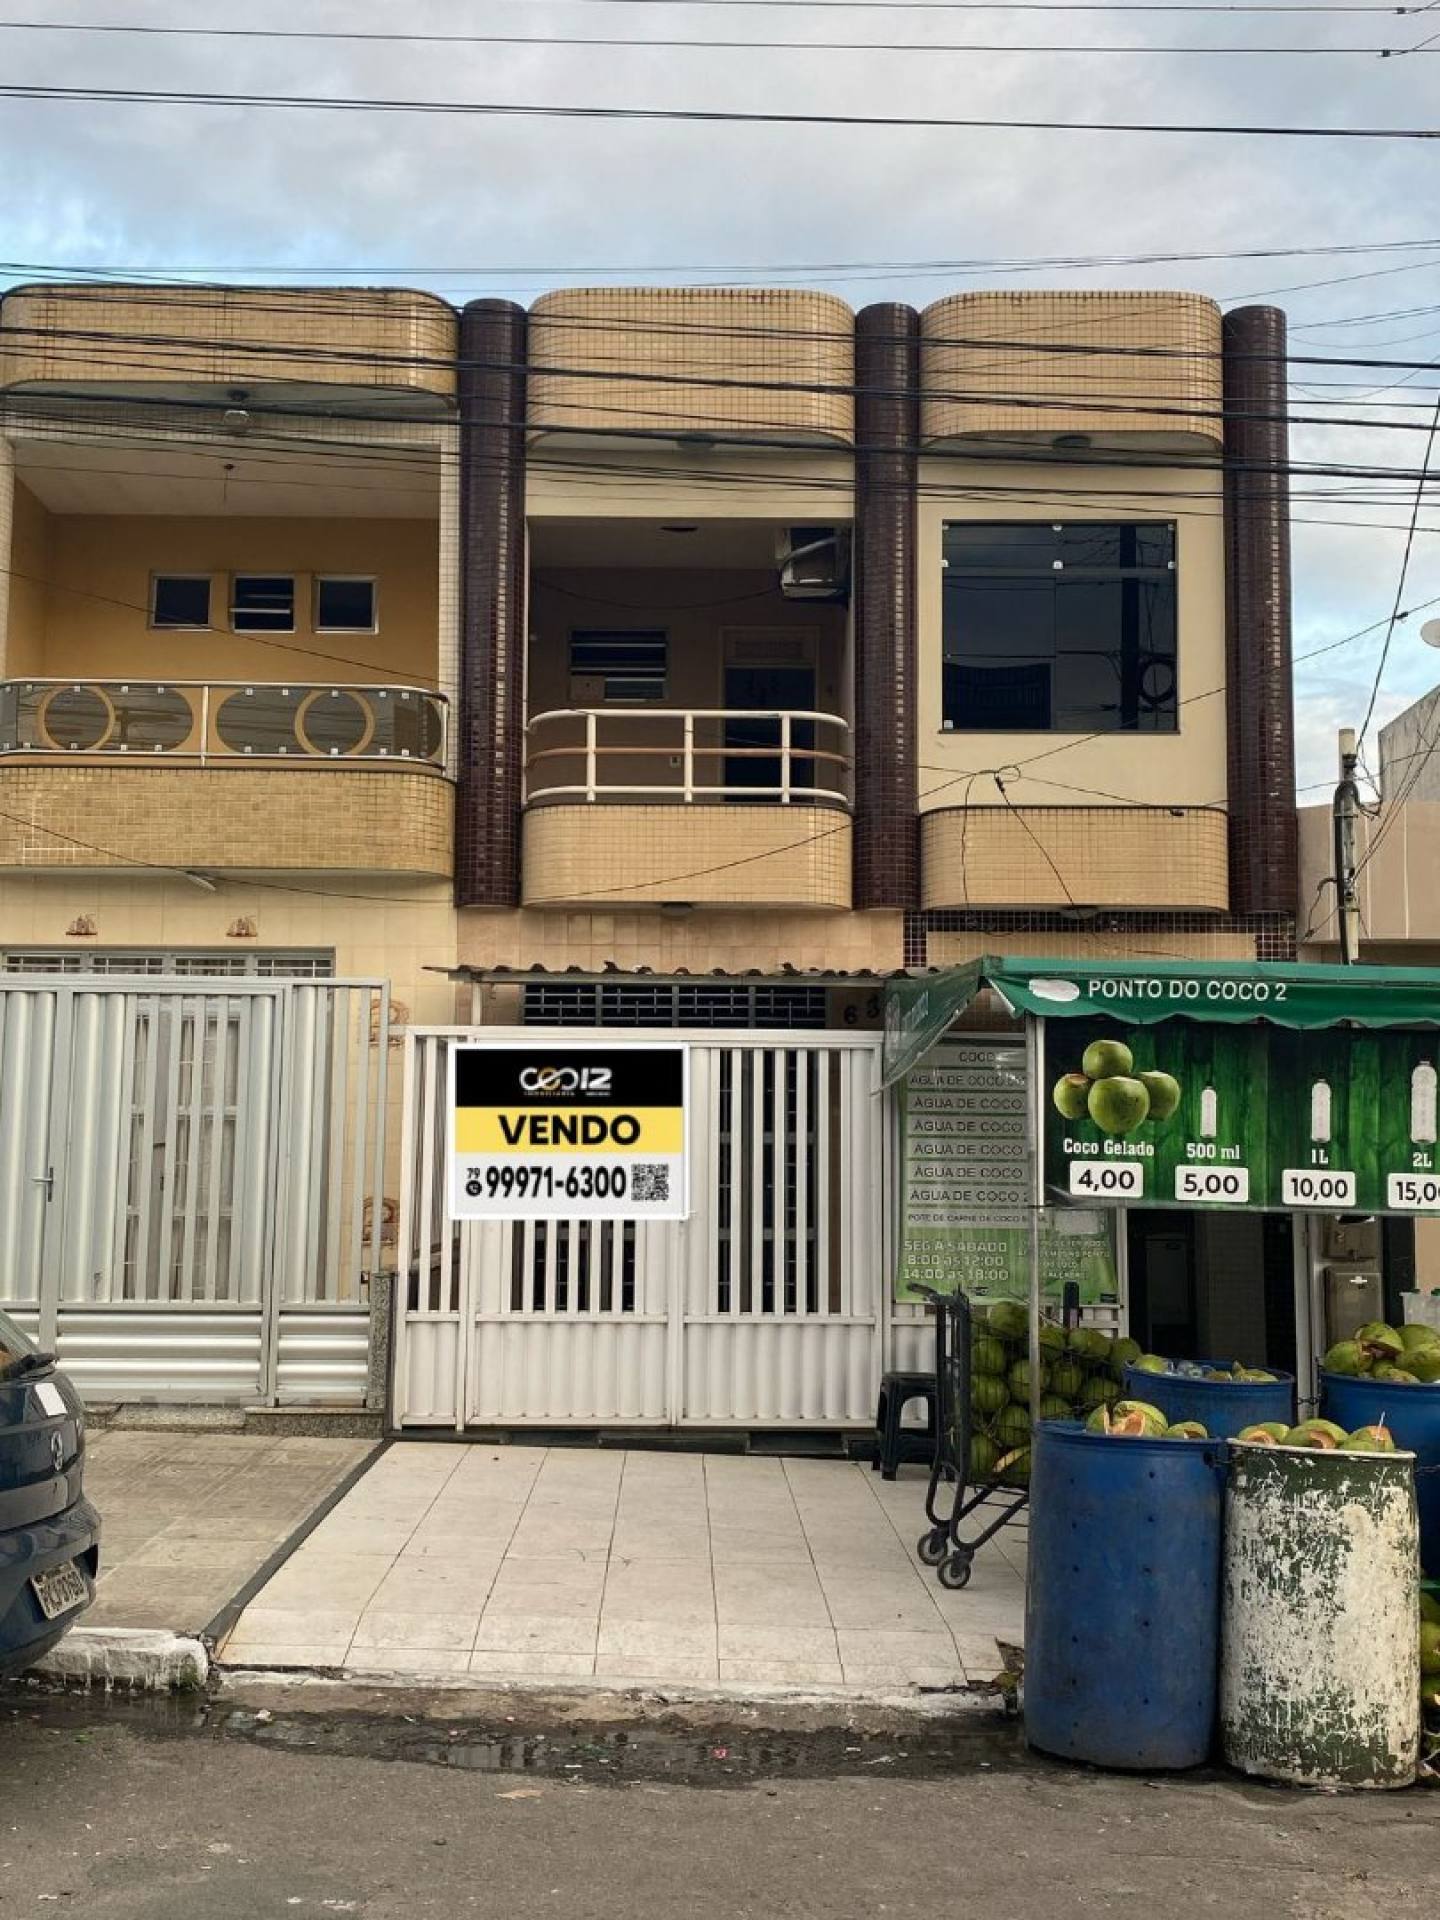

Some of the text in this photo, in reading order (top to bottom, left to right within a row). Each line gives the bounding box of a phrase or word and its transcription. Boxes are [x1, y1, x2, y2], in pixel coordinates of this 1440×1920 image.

[1088, 979, 1287, 1001] PONTO DO COCO 2
[947, 1076, 964, 1086] DE
[957, 1098, 976, 1108] DE
[980, 1098, 1023, 1110] COCO
[497, 1114, 641, 1146] VENDO
[957, 1121, 976, 1131] DE
[980, 1121, 1023, 1133] COCO
[957, 1144, 976, 1154] DE
[980, 1144, 1023, 1156] COCO
[1063, 1138, 1154, 1157] Coco Gelado
[1186, 1143, 1240, 1160] 500 ml
[1412, 1151, 1432, 1168] 2L
[466, 1167, 481, 1179] 79
[957, 1167, 976, 1177] DE
[980, 1167, 1023, 1179] COCO
[1078, 1168, 1135, 1192] 4,00
[485, 1166, 627, 1198] 99971-6300
[1183, 1173, 1240, 1197] 5,00
[1290, 1176, 1348, 1201] 10,00
[953, 1191, 972, 1201] DE
[976, 1191, 1020, 1203] COCO
[1396, 1180, 1440, 1204] 15,0
[904, 1240, 931, 1251] SEG
[907, 1254, 940, 1265] 8:00
[963, 1256, 1004, 1266] 12:00
[903, 1268, 945, 1279] 14:00
[968, 1269, 1009, 1281] 18:00
